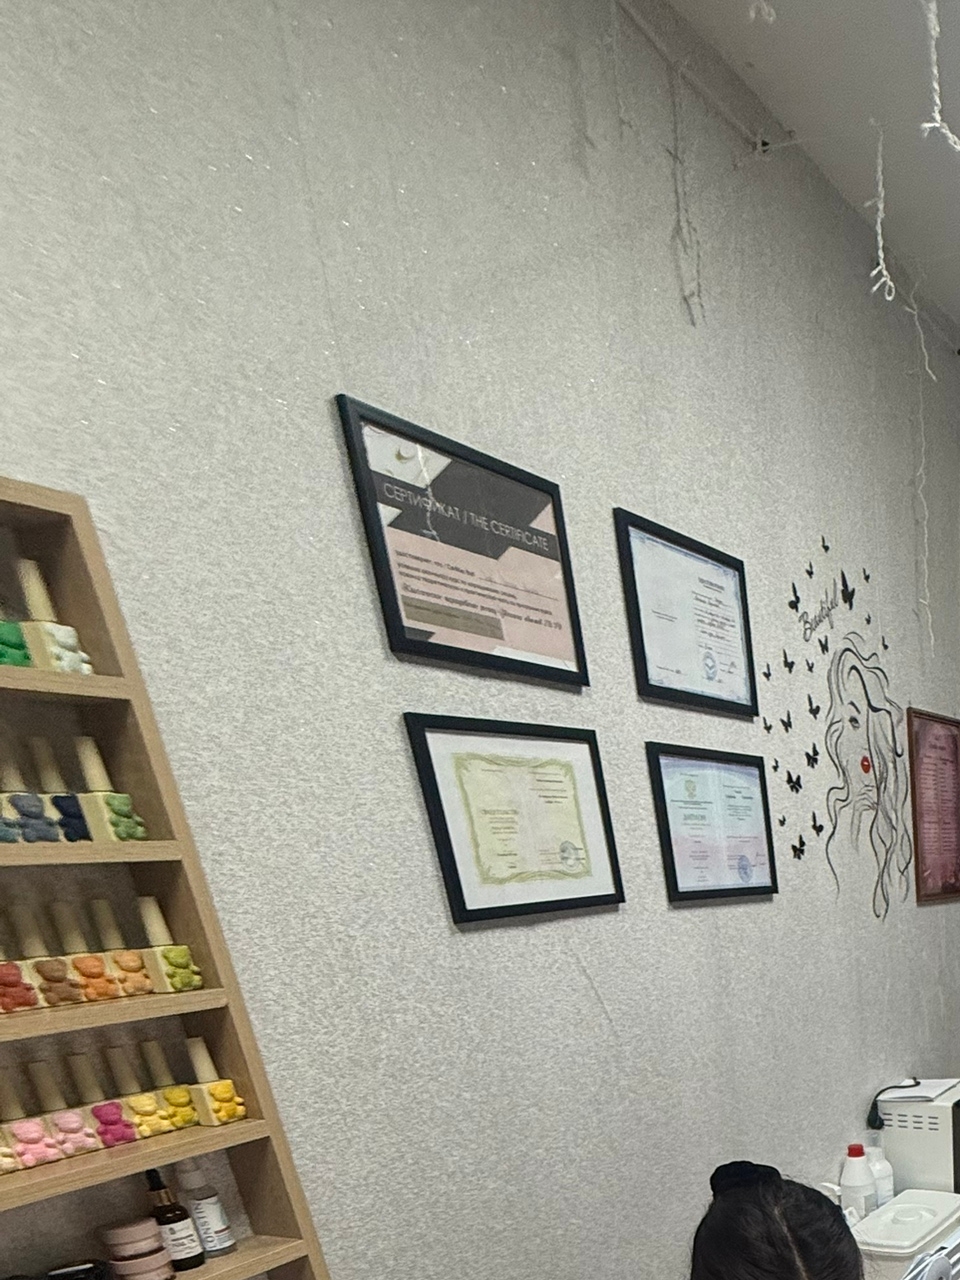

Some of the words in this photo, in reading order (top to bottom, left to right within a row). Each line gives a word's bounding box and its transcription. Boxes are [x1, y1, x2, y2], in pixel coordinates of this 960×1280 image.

[468, 512, 490, 532] THE
[490, 519, 550, 552] CERTIFICATE
[798, 577, 839, 643] Beautiful
